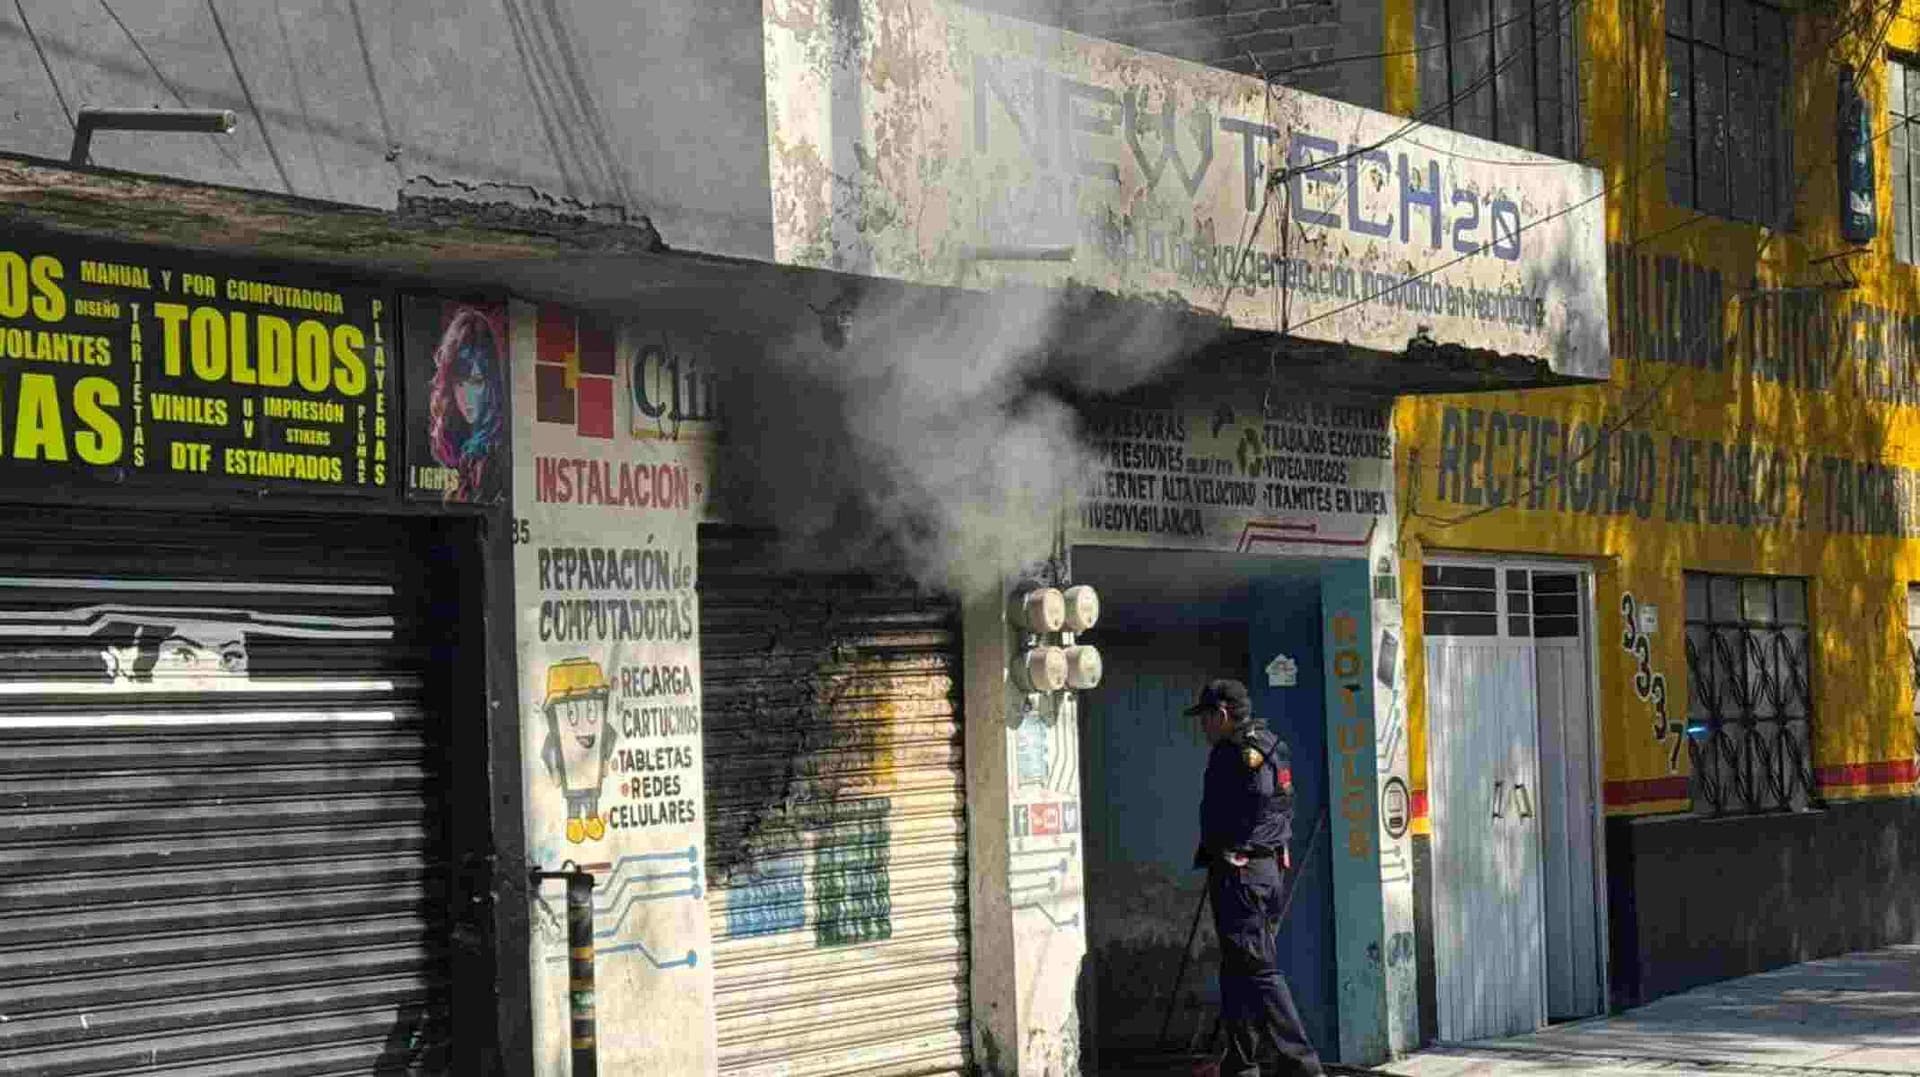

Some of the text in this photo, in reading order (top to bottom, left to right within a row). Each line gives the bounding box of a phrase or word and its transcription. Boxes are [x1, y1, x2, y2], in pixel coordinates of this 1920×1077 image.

[81, 260, 343, 315] MANUAL Y POR COMPUTADORA
[154, 302, 366, 396] TOLDOS
[372, 299, 387, 486] PLAYERAS
[0, 373, 122, 465] AS
[151, 393, 228, 426] VINILES
[264, 396, 344, 423] IMPRESIÓN
[171, 441, 342, 482] DTF ESTAMPADOS
[1437, 406, 1656, 519] RECTIFICADO
[1665, 437, 1699, 523] DE
[1336, 488, 1352, 513] EN
[538, 599, 693, 642] COMPUTADORAS
[621, 665, 693, 698] RECARGA
[623, 706, 698, 738] CARTUCHOS
[618, 746, 693, 773] TABLETAS
[631, 775, 681, 800] REDES
[609, 800, 696, 829] CELULARES
